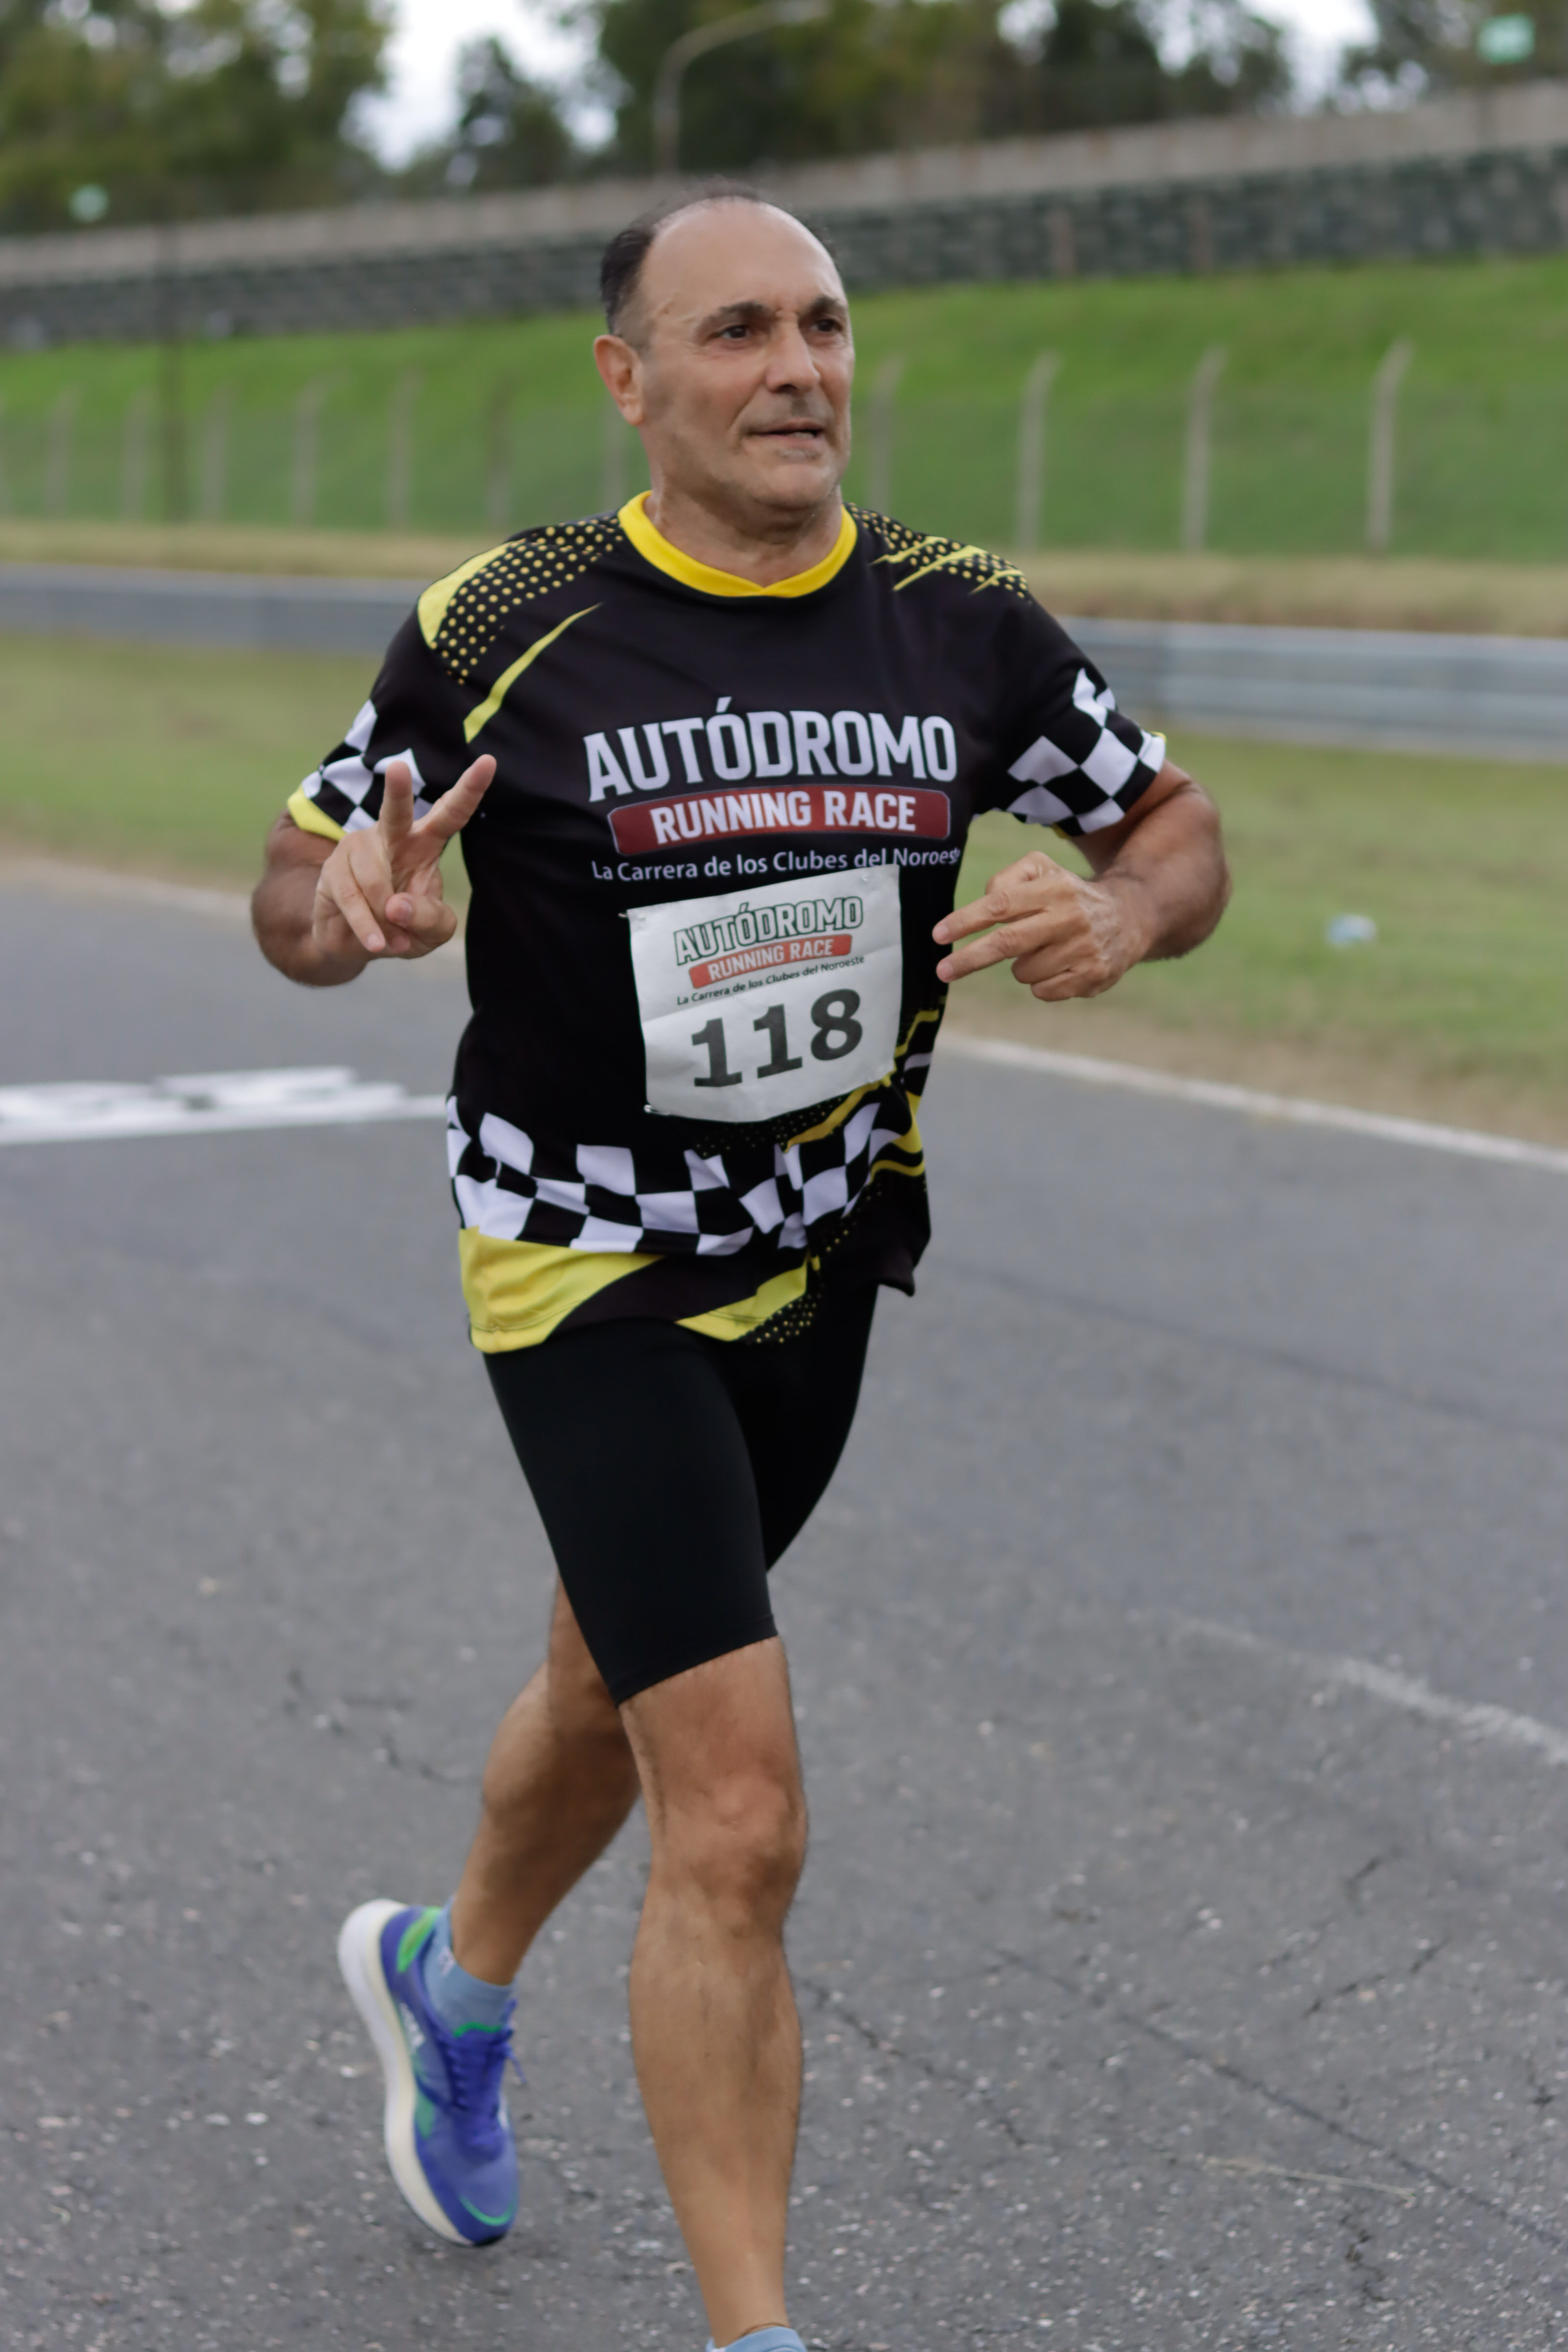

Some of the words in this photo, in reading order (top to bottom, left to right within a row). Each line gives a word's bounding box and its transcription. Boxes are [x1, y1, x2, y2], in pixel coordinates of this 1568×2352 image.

[583, 696, 957, 802] AUTÓDROMO
[649, 790, 812, 845] RUNNING
[823, 791, 917, 832] RACE
[591, 860, 613, 880] La
[617, 862, 698, 882] Carrera
[704, 856, 732, 877] de
[736, 854, 768, 875] los
[773, 850, 848, 871] Clubes
[854, 848, 886, 868] del
[673, 896, 863, 966] AUTÓDROMO
[677, 996, 689, 1005] La
[691, 986, 730, 1002] Carrera
[733, 982, 746, 992] de
[748, 978, 763, 989] los
[765, 971, 800, 985] Clubes
[802, 967, 818, 977] del
[821, 955, 865, 972] Noroeste
[708, 945, 784, 981] RUNNING
[790, 938, 834, 961] RACE
[691, 988, 863, 1088] 118
